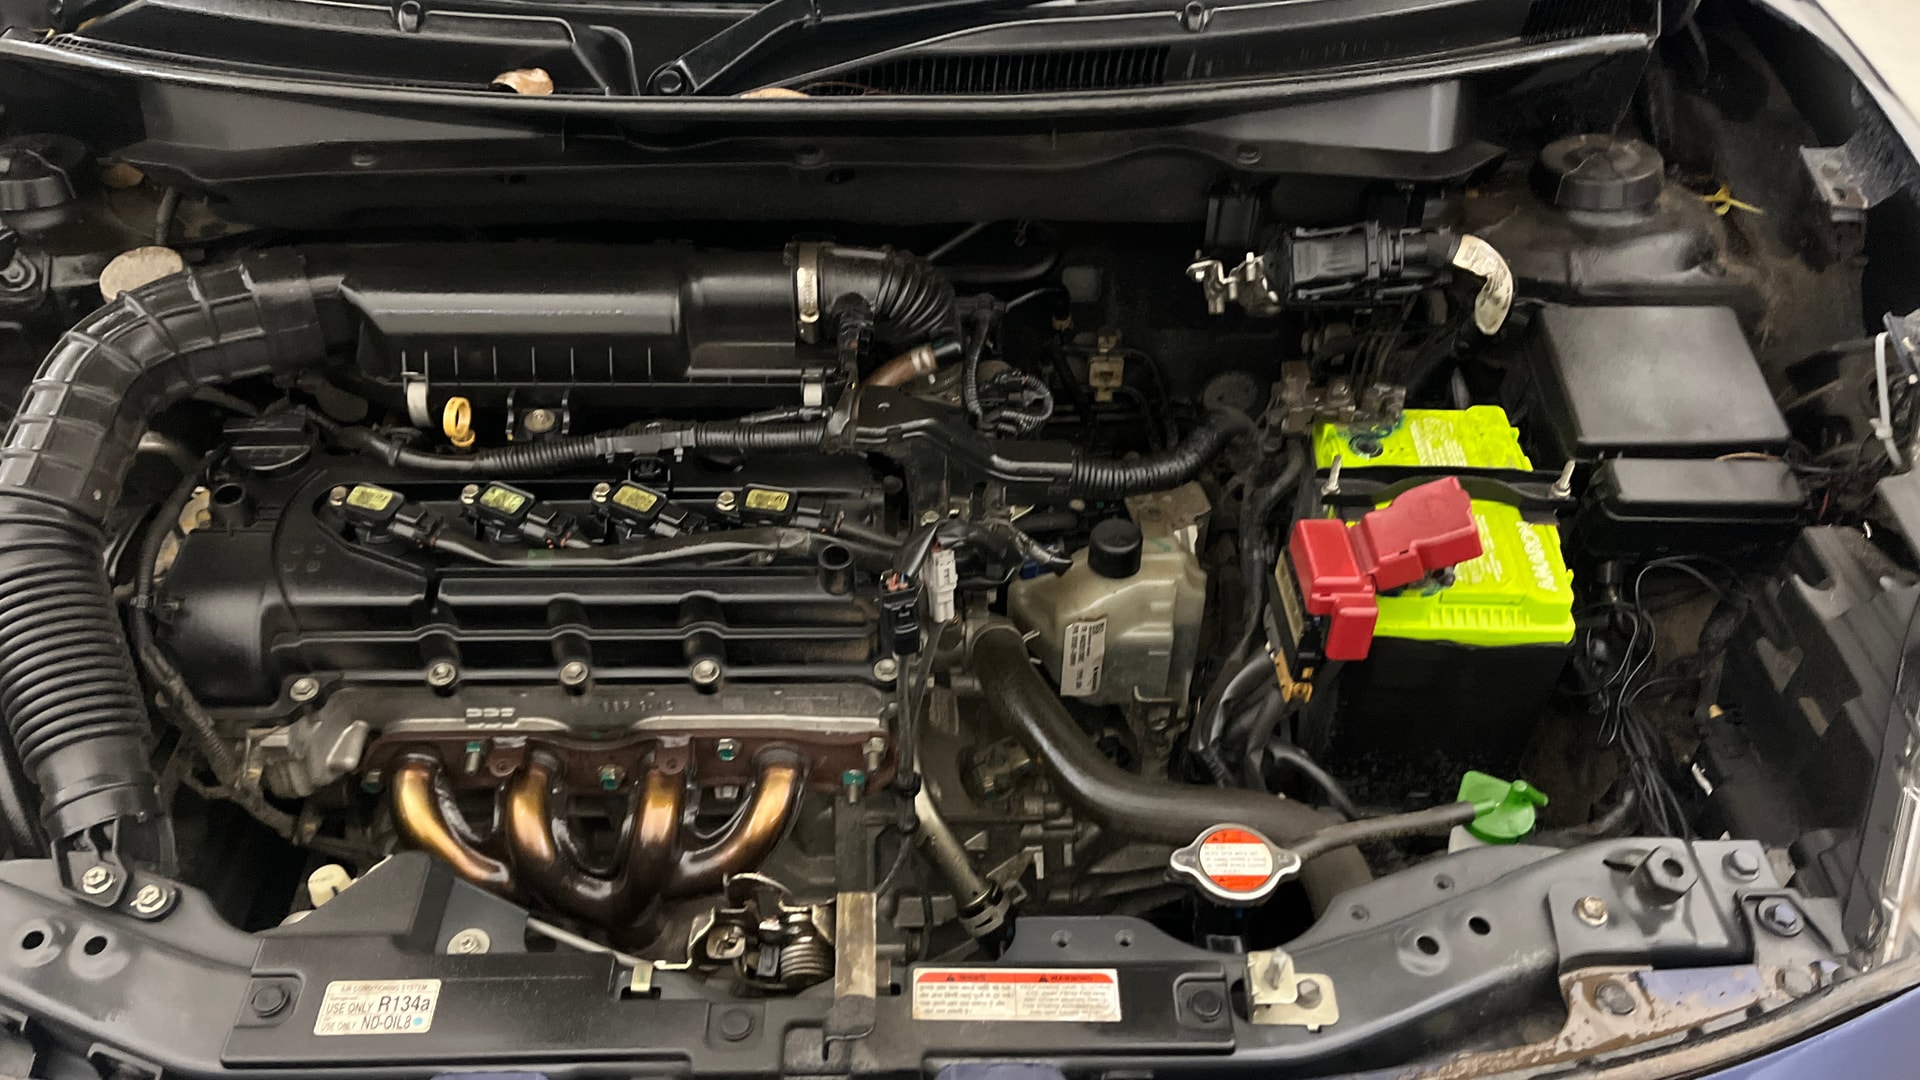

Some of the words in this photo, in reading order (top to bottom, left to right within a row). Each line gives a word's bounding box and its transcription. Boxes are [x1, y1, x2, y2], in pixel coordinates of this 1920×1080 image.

[326, 1003, 345, 1013] USE
[349, 1002, 374, 1013] ONLY
[378, 995, 431, 1012] R134a
[321, 1022, 336, 1031] USE
[361, 1015, 411, 1030] ND-OIL8
